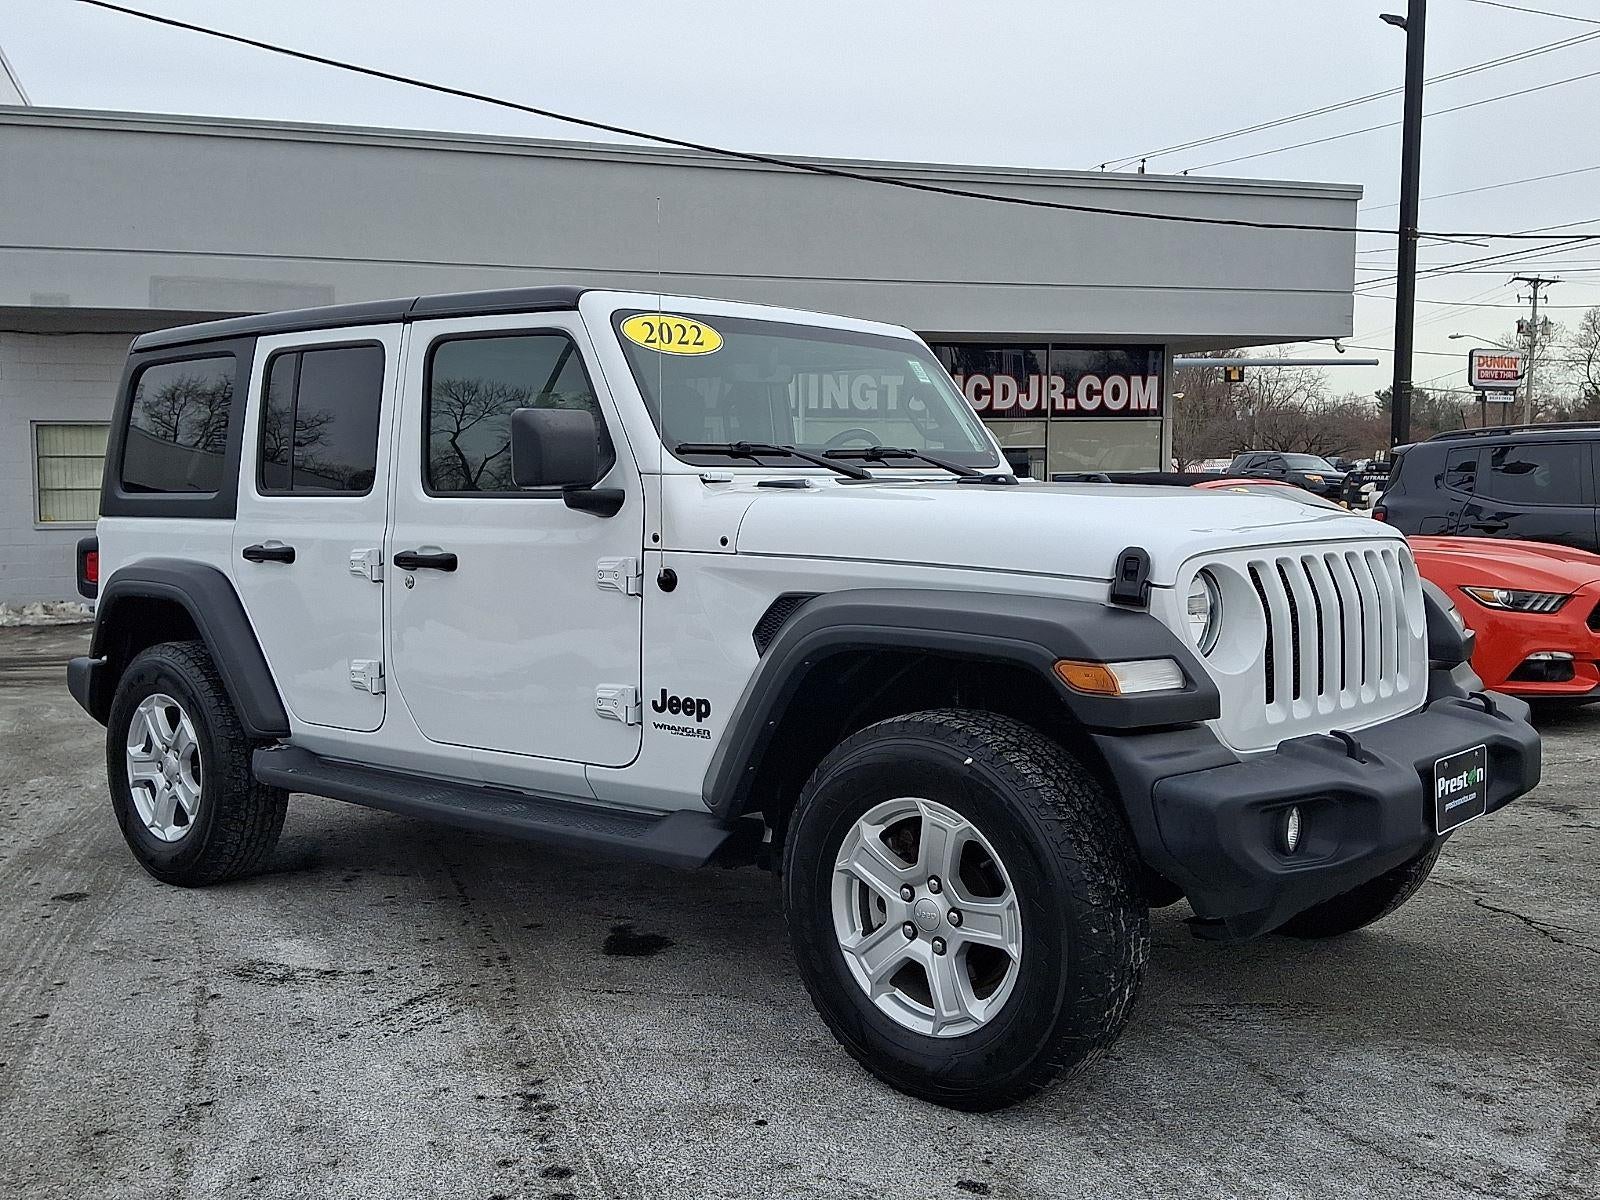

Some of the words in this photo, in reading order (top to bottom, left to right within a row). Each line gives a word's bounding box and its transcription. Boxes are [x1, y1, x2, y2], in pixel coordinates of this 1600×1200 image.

[641, 321, 705, 346] 2022
[1480, 370, 1499, 379] DRIVE
[651, 688, 711, 723] Jeep
[652, 721, 711, 737] WRANGLER
[670, 730, 711, 740] UNLIMITED
